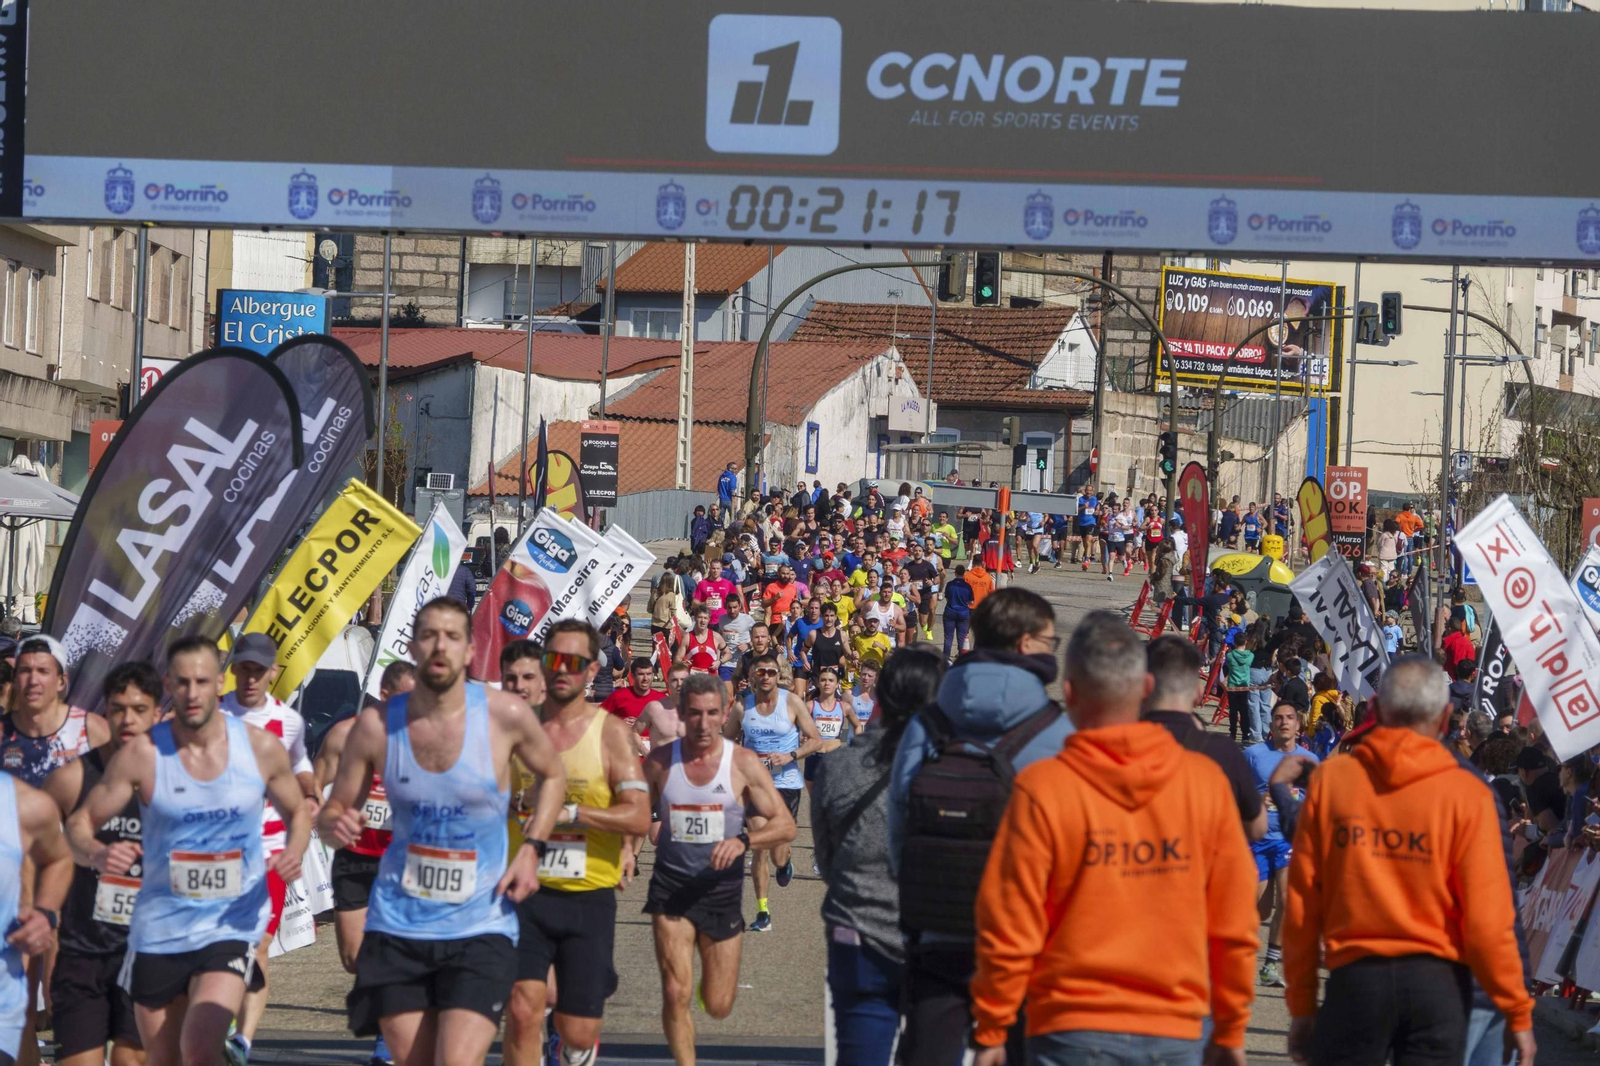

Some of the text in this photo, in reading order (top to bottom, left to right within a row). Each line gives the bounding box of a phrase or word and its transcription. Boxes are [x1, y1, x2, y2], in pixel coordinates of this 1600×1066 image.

[866, 51, 1188, 107] CCNORTE
[909, 110, 1140, 131] ALL FOR SPORTS EVENTS
[164, 183, 229, 203] Porriño
[348, 188, 413, 208] Porriño
[532, 193, 597, 213] Porriño
[726, 184, 961, 236] 00:21:17
[1083, 208, 1148, 228] Porriño
[1267, 213, 1332, 233] Porriño
[1451, 218, 1516, 238] Porriño
[1169, 274, 1184, 286] LUZ
[1185, 278, 1190, 289] y
[1191, 276, 1207, 288] GAS
[1220, 281, 1233, 289] buen
[230, 295, 317, 322] Albergue
[1174, 292, 1209, 314] 0,109
[1236, 298, 1273, 319] 0,069
[224, 320, 243, 343] El
[1183, 342, 1193, 353] YA
[1194, 343, 1205, 354] TU
[1206, 345, 1226, 356] PACK
[1227, 346, 1262, 360] AORRO!
[1180, 360, 1193, 370] 334
[1193, 361, 1205, 371] 732
[1227, 365, 1254, 375] ernández
[308, 405, 352, 474] cocinas
[222, 430, 276, 503] cocinas
[1331, 470, 1363, 478] oporriño
[88, 417, 258, 620] LASAL
[533, 528, 571, 563] Giga
[265, 508, 382, 650] ELECPOR
[588, 562, 635, 616] Maceira
[285, 604, 330, 660] INSTALACIONES
[334, 539, 383, 599] MANTENIMIENTO
[382, 527, 394, 540] S.L.
[533, 557, 600, 646] doy Maceira
[505, 604, 529, 627] Giga
[1333, 577, 1380, 673] LASAL
[821, 723, 836, 733] 284
[366, 804, 388, 823] 551
[685, 816, 708, 835] 251
[187, 868, 227, 890] 849
[417, 863, 463, 892] 1009
